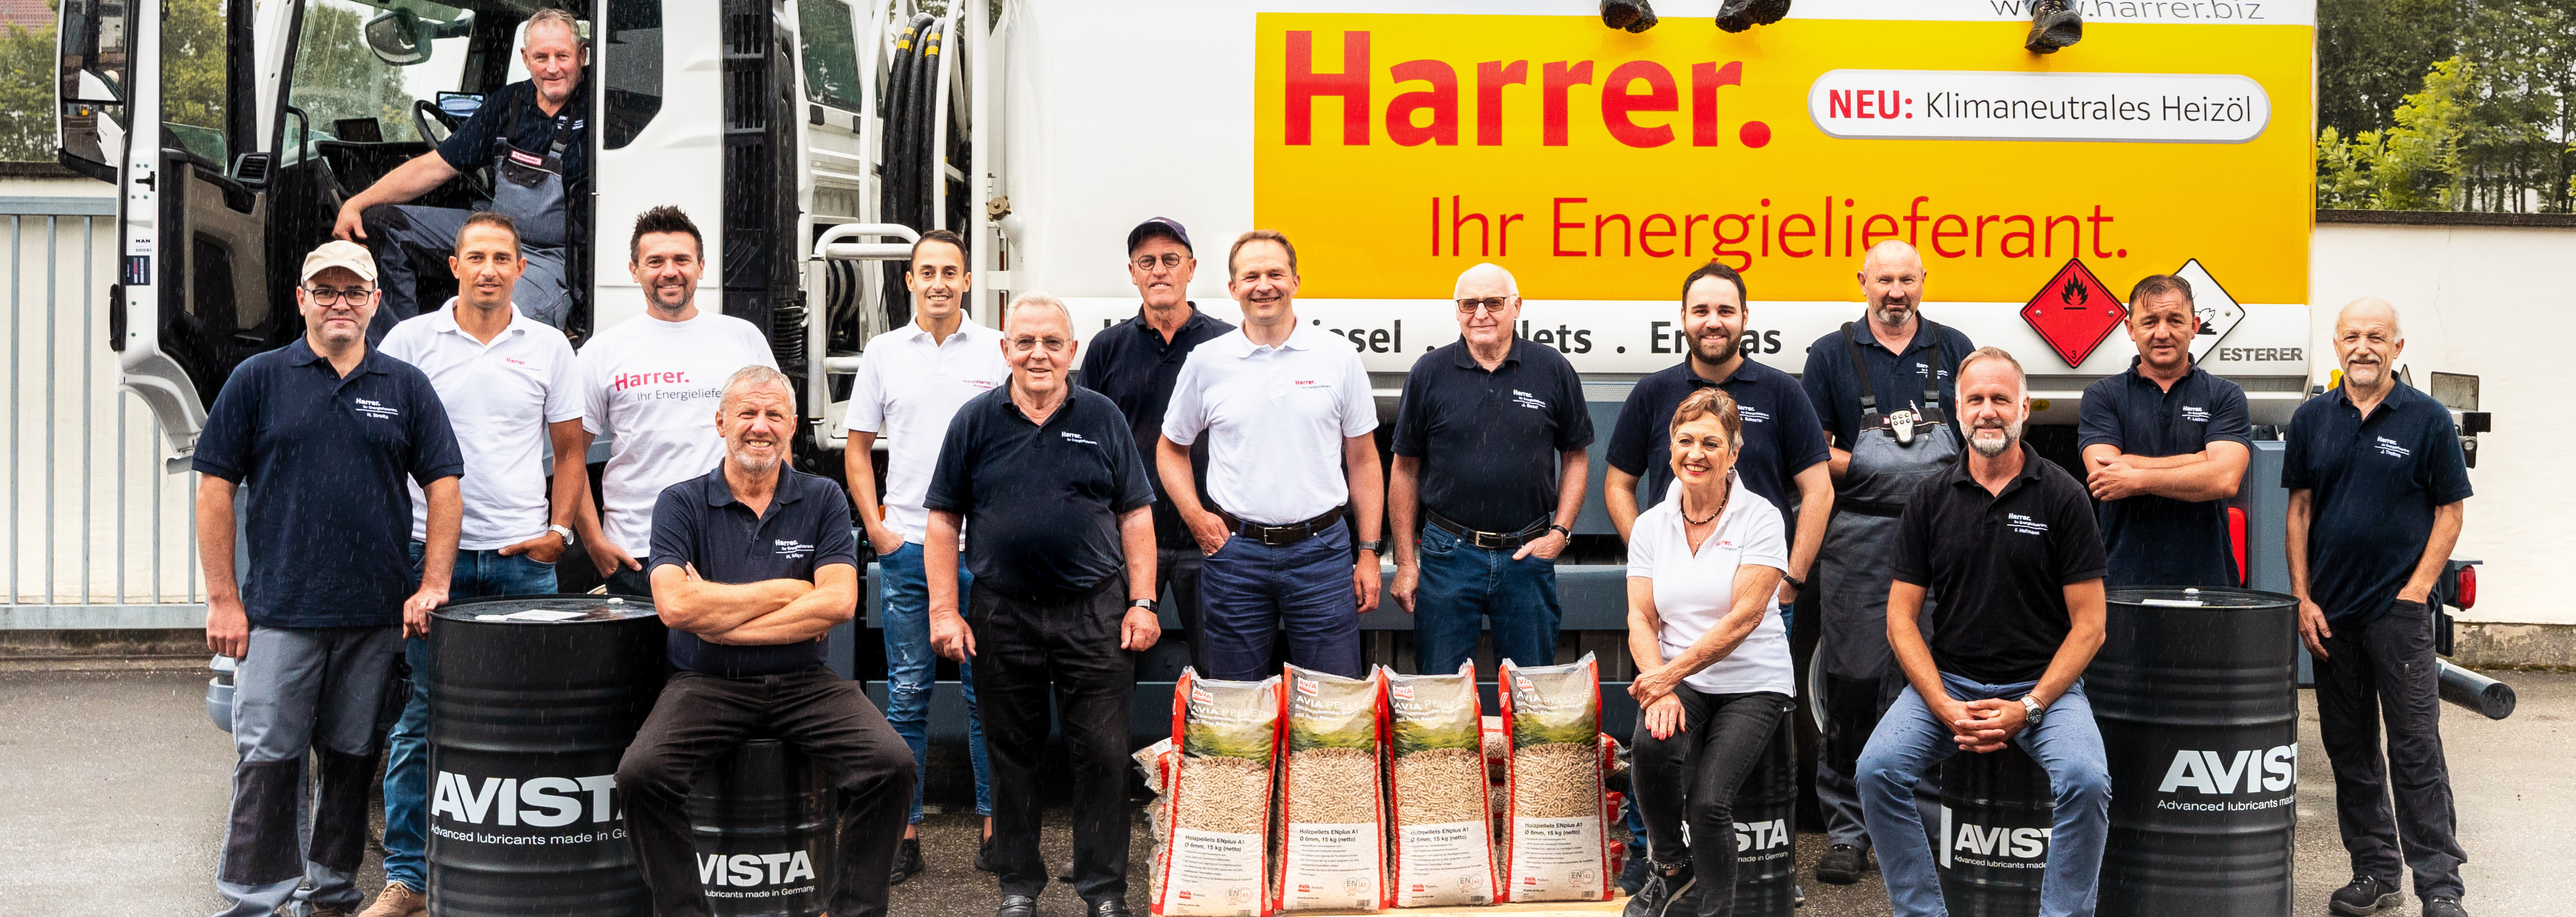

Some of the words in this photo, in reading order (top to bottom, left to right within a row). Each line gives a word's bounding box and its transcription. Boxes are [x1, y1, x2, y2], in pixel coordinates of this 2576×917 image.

[1993, 0, 2264, 19] w.harrer.biz
[1284, 30, 1771, 149] Harrer.
[1829, 89, 1913, 120] NEU:
[1927, 92, 2151, 121] Klimaneutrales
[2162, 96, 2251, 122] Heizöl
[1432, 194, 1524, 258] Ihr
[1553, 195, 2127, 274] Energielieferant.
[2071, 350, 2076, 359] 3
[2219, 348, 2303, 361] ESTERER
[615, 372, 690, 392] Harrer.
[637, 392, 652, 401] Ihr
[656, 388, 722, 401] Energieliefe
[355, 397, 381, 406] Harrer.
[2377, 436, 2397, 445] Harrer.
[1299, 680, 1316, 689] AVIA
[1194, 690, 1211, 699] AVIA
[1516, 690, 1541, 702] AVIA
[1543, 689, 1591, 704] PELLETS
[1297, 695, 1322, 708] AVIA
[1192, 705, 1218, 714] AVIA
[431, 771, 623, 827] AVIST
[2157, 800, 2223, 811] Advanced
[2228, 799, 2278, 810] lubricants
[431, 823, 473, 842] Advanced
[477, 832, 545, 845] lubricants
[551, 831, 592, 844] made
[597, 831, 608, 841] in
[1954, 855, 1985, 866] Advanced
[696, 850, 815, 887] VISTA
[705, 890, 743, 898] lubricants
[781, 885, 815, 895] Germany.
